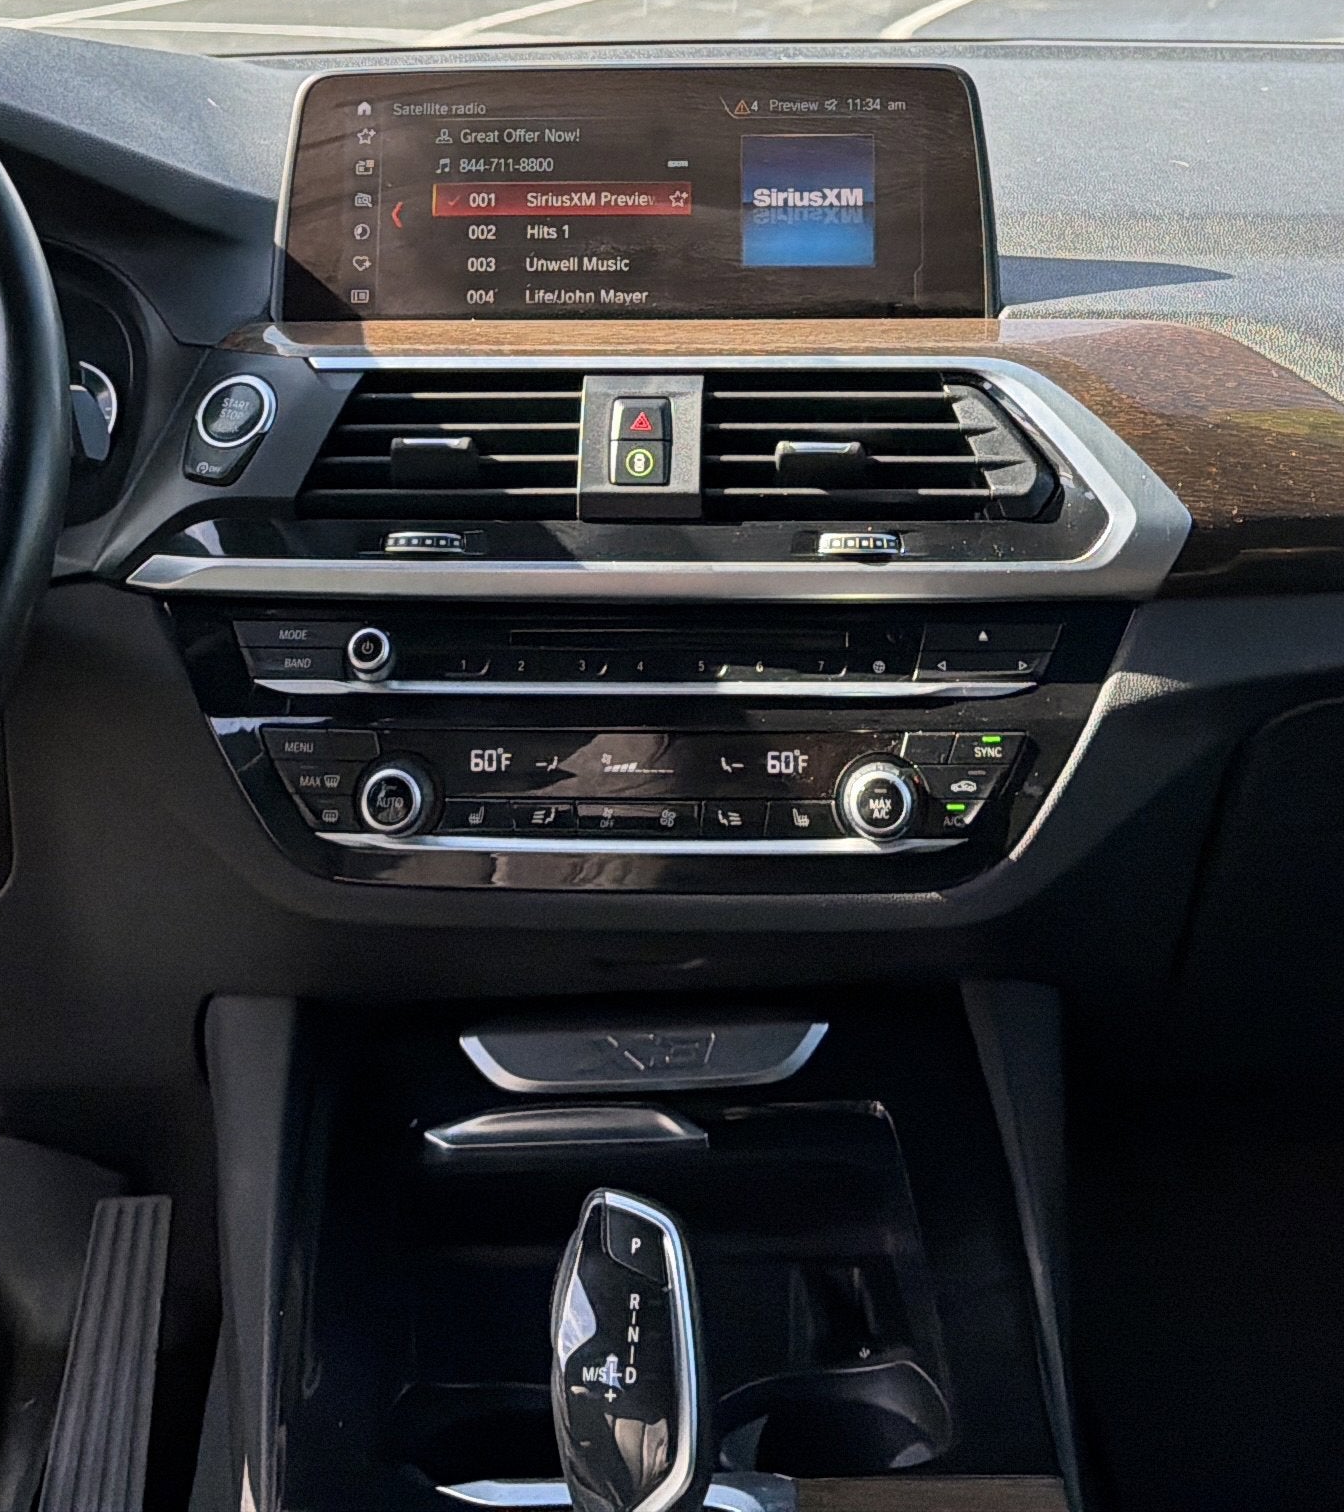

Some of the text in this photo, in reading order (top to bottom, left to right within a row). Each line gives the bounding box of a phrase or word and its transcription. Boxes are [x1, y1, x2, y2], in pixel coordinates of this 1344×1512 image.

[392, 102, 487, 116] Satellite radio
[750, 98, 906, 112] 4 Preview 11:34 am
[460, 128, 581, 144] Great Offer Now!
[459, 158, 554, 173] 844-711-8800
[469, 193, 496, 207] 001
[526, 192, 596, 207] SiriusXM
[752, 188, 864, 207] SiriusXM
[468, 225, 570, 240] 002 Hits 1
[467, 257, 630, 272] 003 Unwell Music
[466, 289, 649, 306] 004 Life/John Mayer
[222, 398, 249, 409] START
[278, 629, 308, 640] MODE
[284, 658, 312, 669] BAND
[460, 659, 467, 671] 1
[517, 660, 525, 672] 2
[578, 659, 587, 672] 3
[636, 660, 645, 672] 4
[697, 660, 705, 673] 5
[755, 660, 764, 673] 6
[817, 660, 825, 673] 7
[284, 742, 315, 753] MENU
[974, 746, 1003, 759] SYNC
[299, 776, 321, 787] MAX
[375, 796, 405, 809] AUTO
[868, 797, 893, 810] MAX
[872, 808, 891, 820] A/C
[599, 819, 616, 829] OFF
[630, 1237, 642, 1255] P
[629, 1292, 641, 1311] R
[626, 1326, 640, 1344] N
[581, 1366, 607, 1384] M/S
[624, 1366, 638, 1385] D
